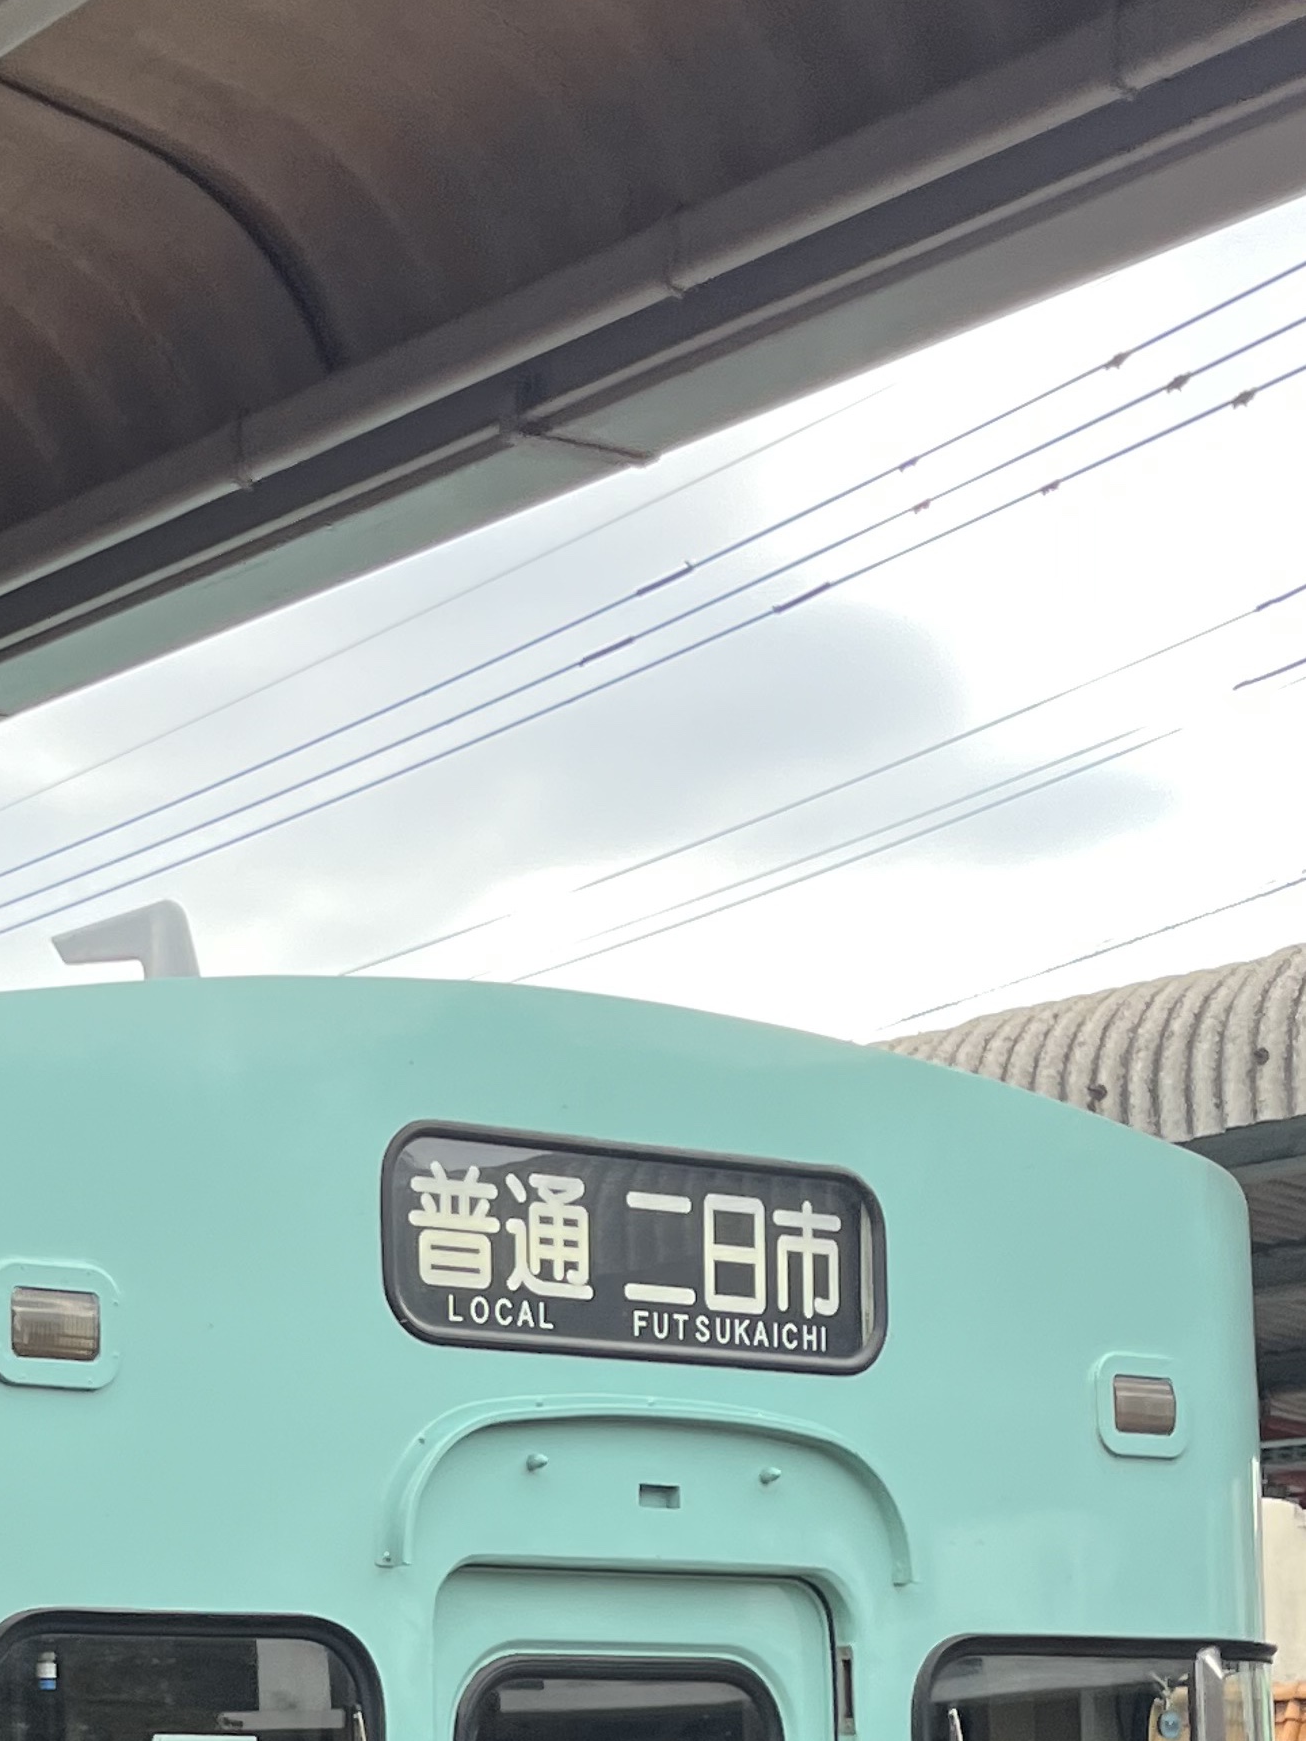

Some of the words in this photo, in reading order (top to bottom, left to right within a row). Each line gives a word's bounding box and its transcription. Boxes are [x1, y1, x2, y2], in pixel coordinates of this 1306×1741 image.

[408, 1161, 594, 1301] 普通
[624, 1192, 842, 1320] 二日市
[448, 1294, 554, 1330] LOCAL
[632, 1311, 828, 1353] FUTSUKAICHI
